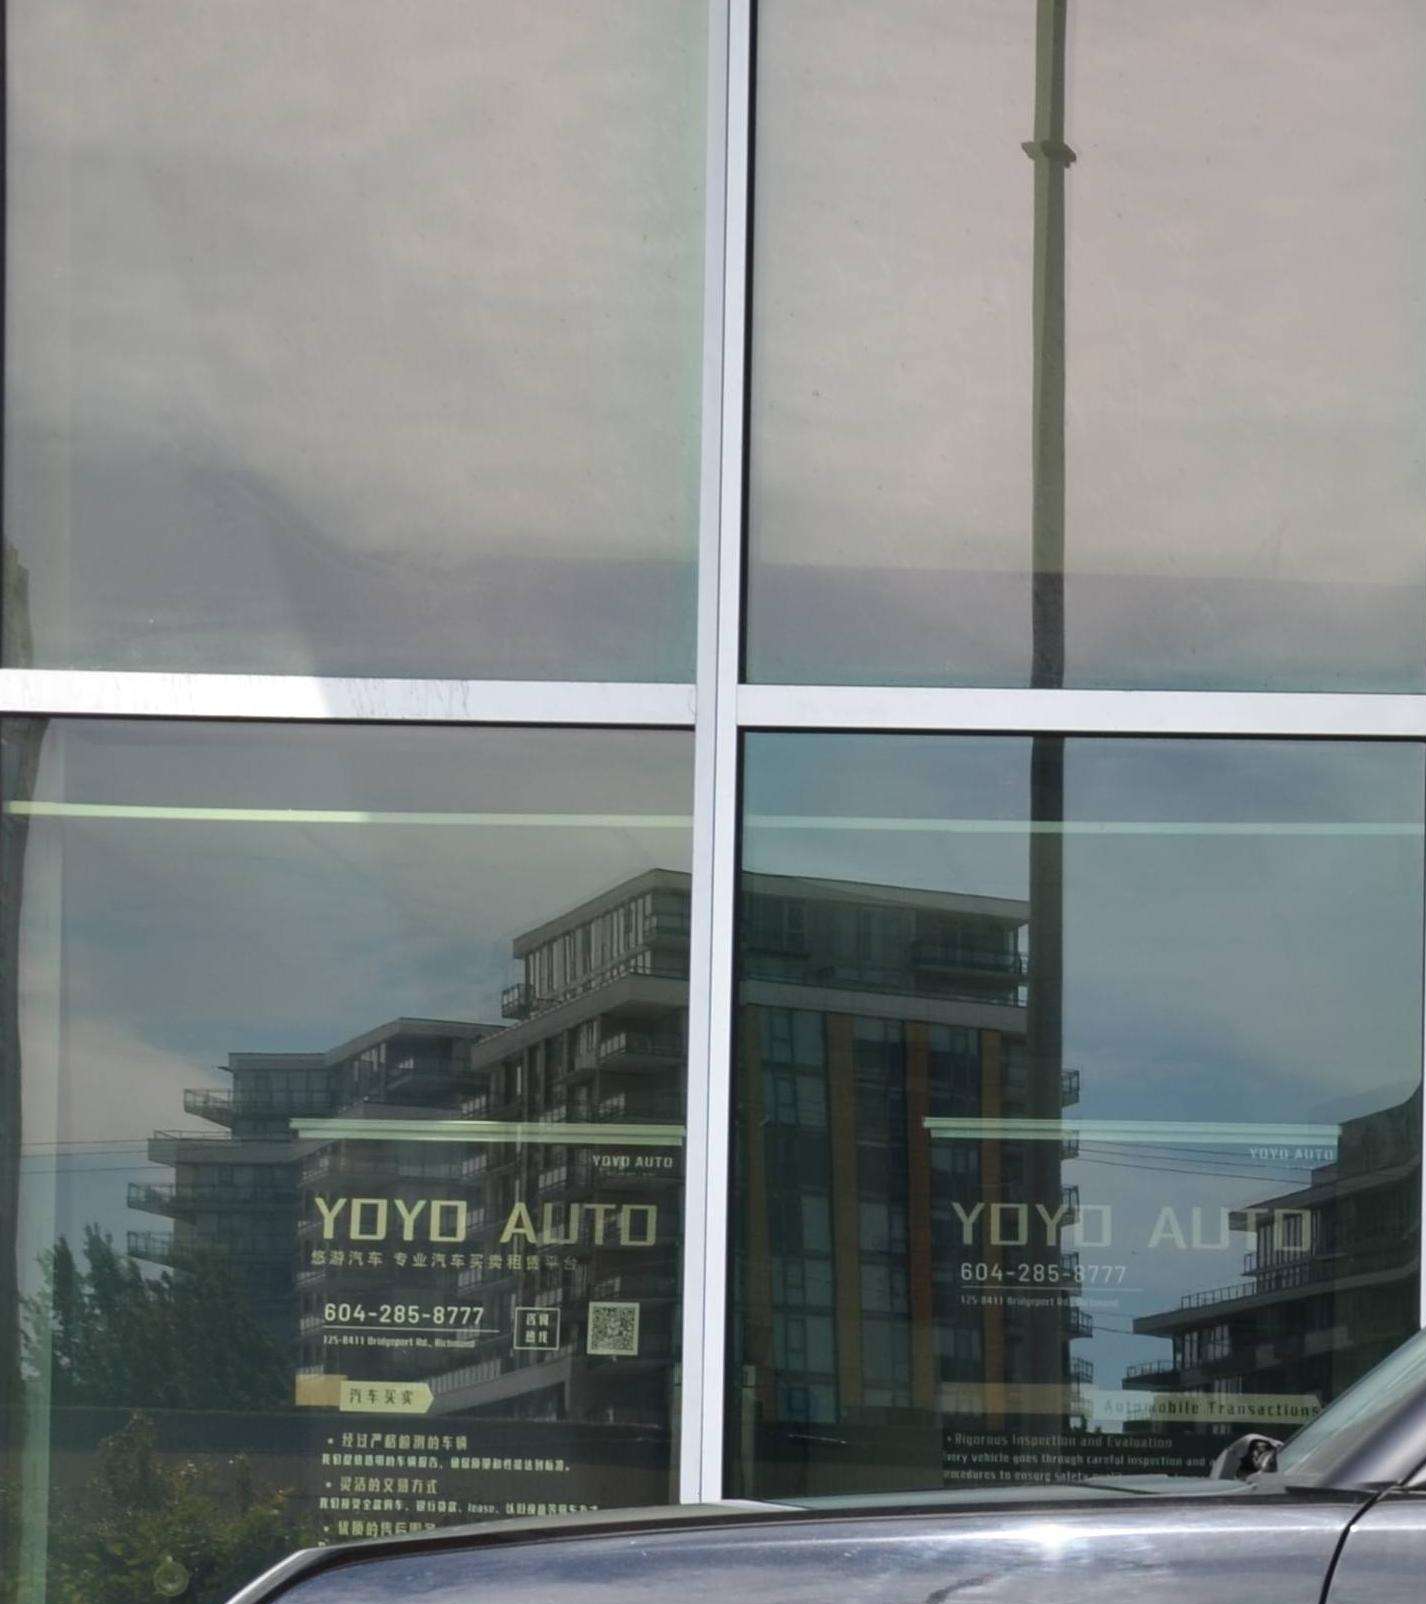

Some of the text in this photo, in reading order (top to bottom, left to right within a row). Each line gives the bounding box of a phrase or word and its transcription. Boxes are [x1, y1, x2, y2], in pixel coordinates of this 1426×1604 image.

[592, 1154, 673, 1168] YOYO AUTO
[1250, 1148, 1333, 1160] YOYO AUTO
[315, 1197, 659, 1247] YOYO AUTO
[952, 1201, 1312, 1252] YOYO AUTO
[960, 1262, 1127, 1285] 604-285-8777
[324, 1302, 485, 1326] 604-285-8777
[349, 1387, 415, 1405] 汽车买卖
[1208, 1401, 1322, 1417] Transactions
[1106, 1434, 1173, 1448] Evaluation
